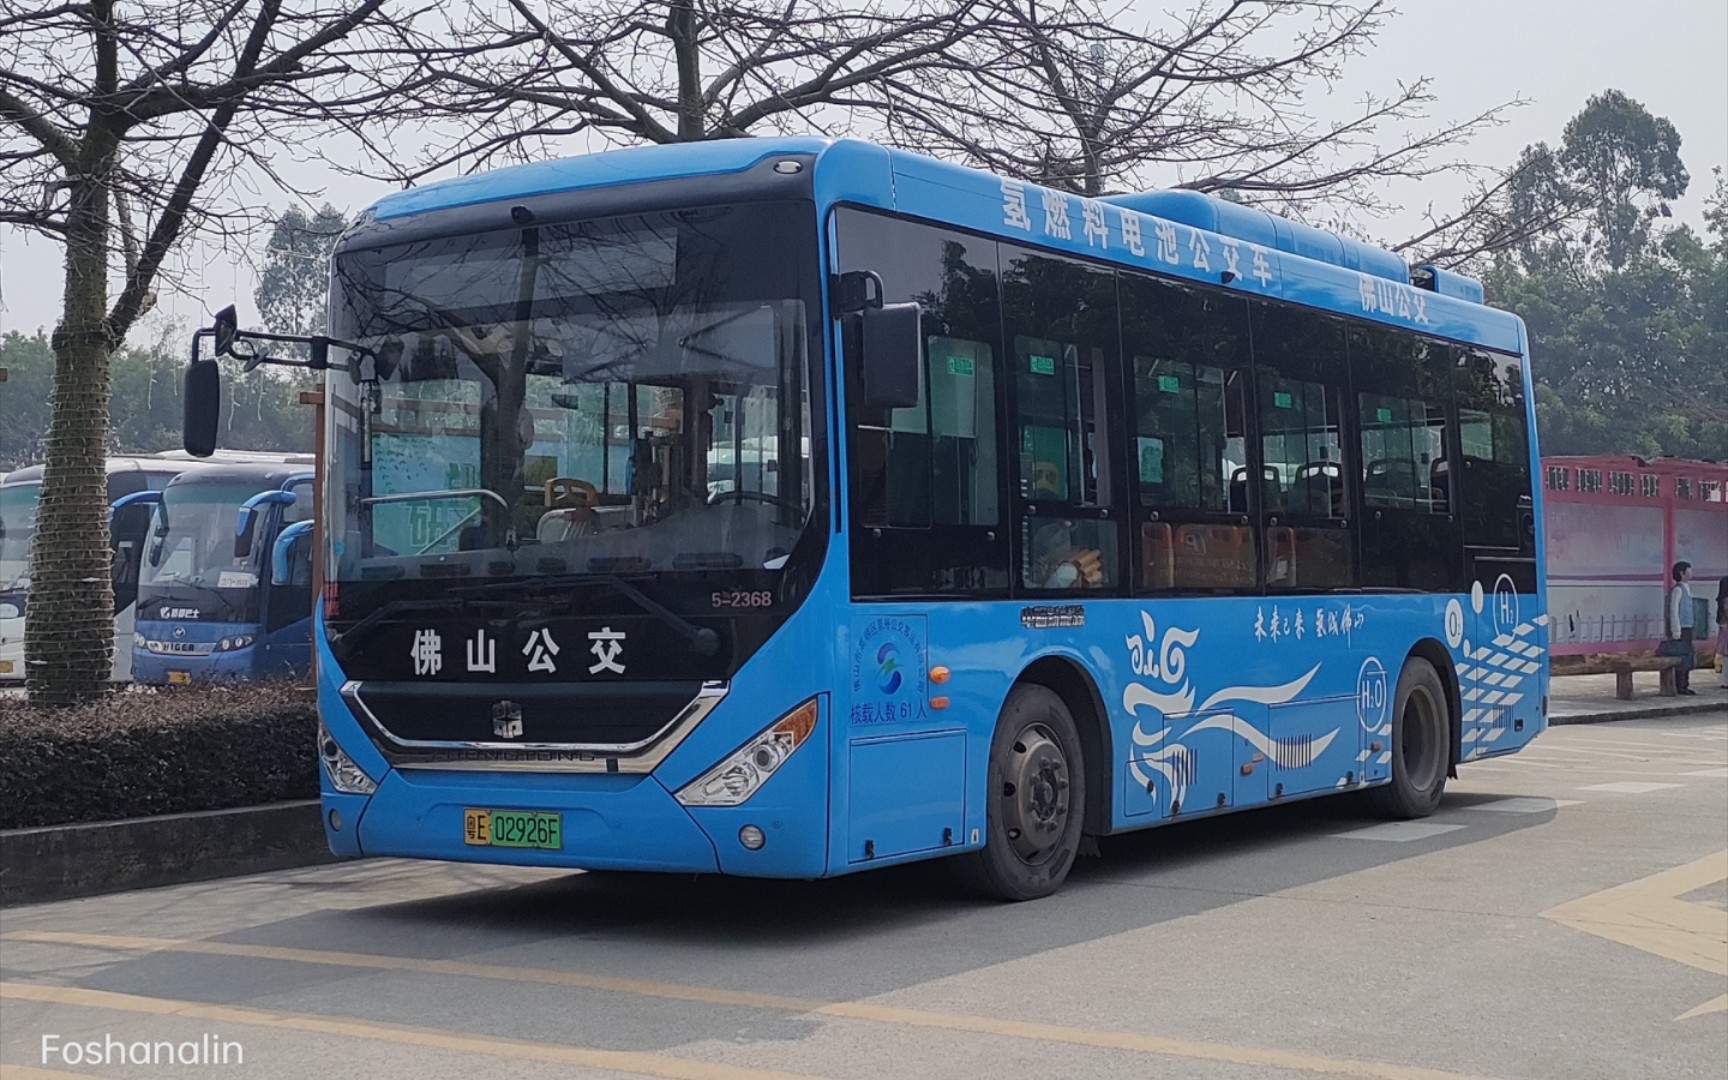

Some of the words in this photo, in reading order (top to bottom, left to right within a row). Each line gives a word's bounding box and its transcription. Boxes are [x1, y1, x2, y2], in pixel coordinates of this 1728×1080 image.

[1001, 178, 1273, 288] 氢燃料电池公交车
[1359, 272, 1429, 325] 佛山公交
[711, 590, 772, 608] 5-2368
[410, 626, 627, 676] 佛山公交
[850, 701, 896, 725] 核载人数
[495, 816, 558, 844] 02926F
